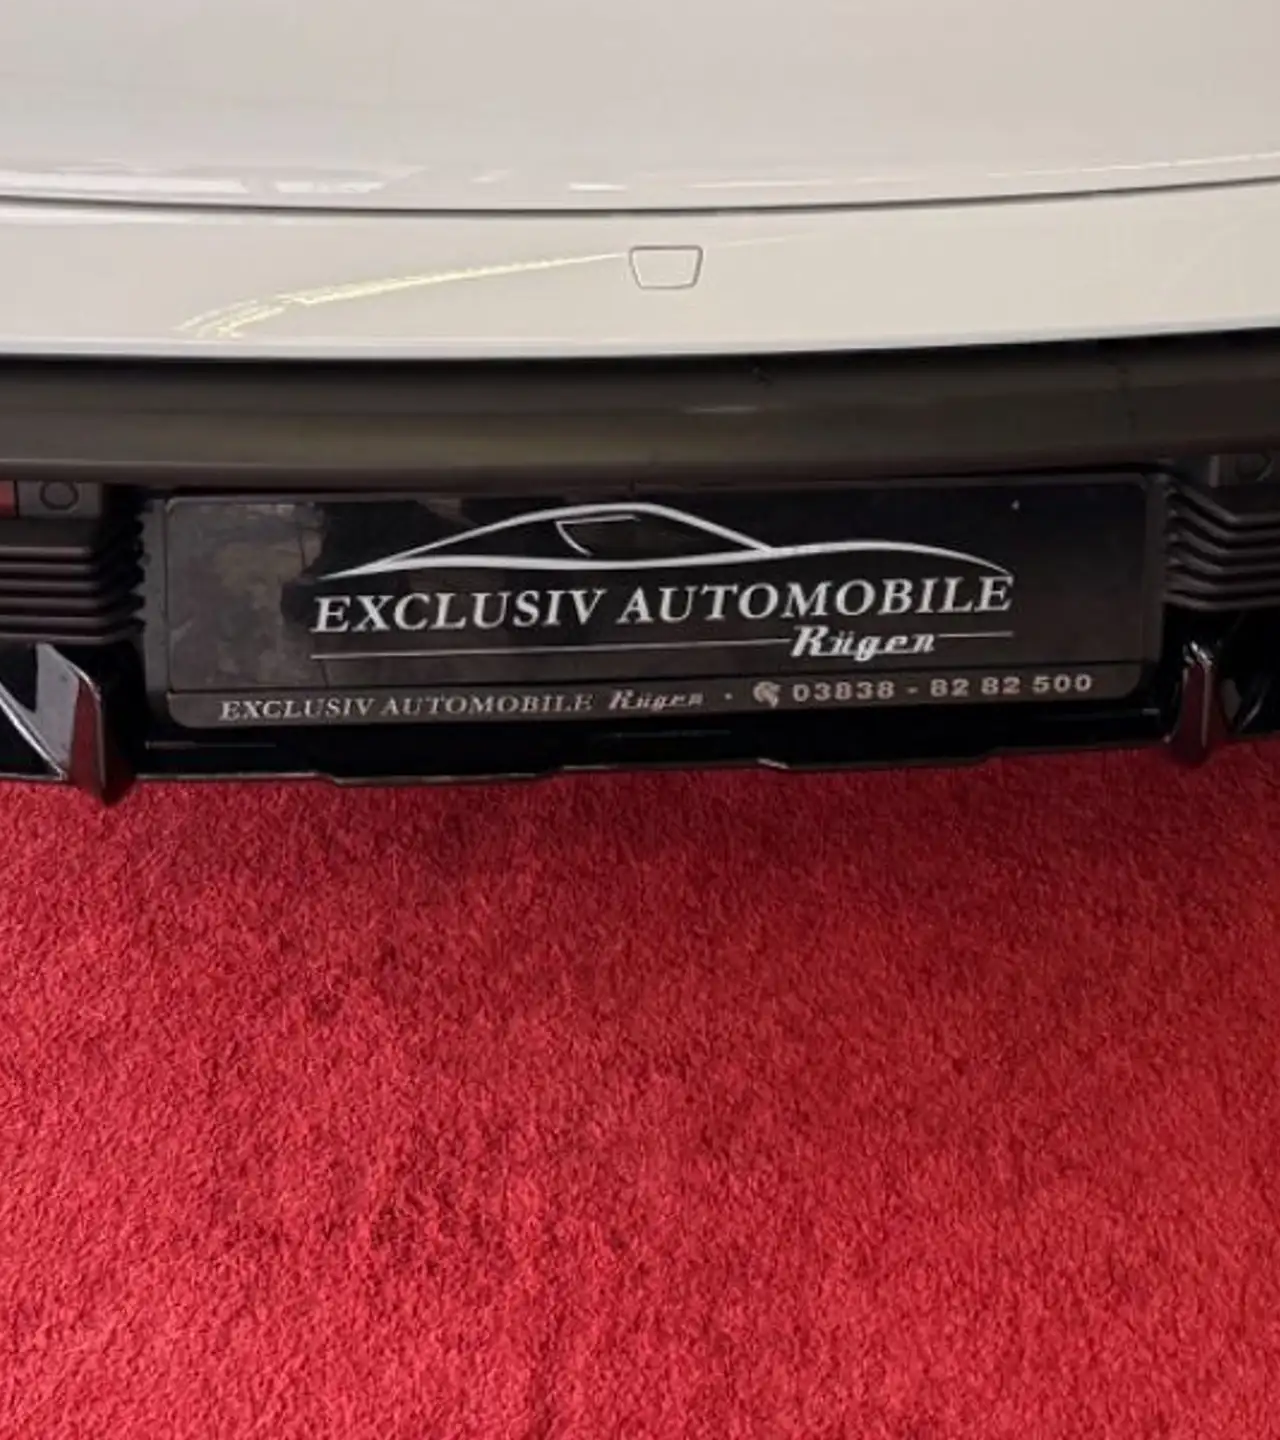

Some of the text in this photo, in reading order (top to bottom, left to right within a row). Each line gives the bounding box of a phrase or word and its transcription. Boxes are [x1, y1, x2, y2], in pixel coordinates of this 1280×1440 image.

[310, 575, 1016, 634] EXCLUSIV AUTOMOBILE
[790, 624, 936, 662] Rügen
[219, 697, 380, 723] EXCLUSIV
[379, 691, 596, 717] AUTOMOBILE
[607, 689, 705, 713] Rügen
[792, 680, 896, 703] 03838
[929, 678, 971, 698] 82
[980, 676, 1021, 696] 82
[1031, 673, 1094, 694] 500
